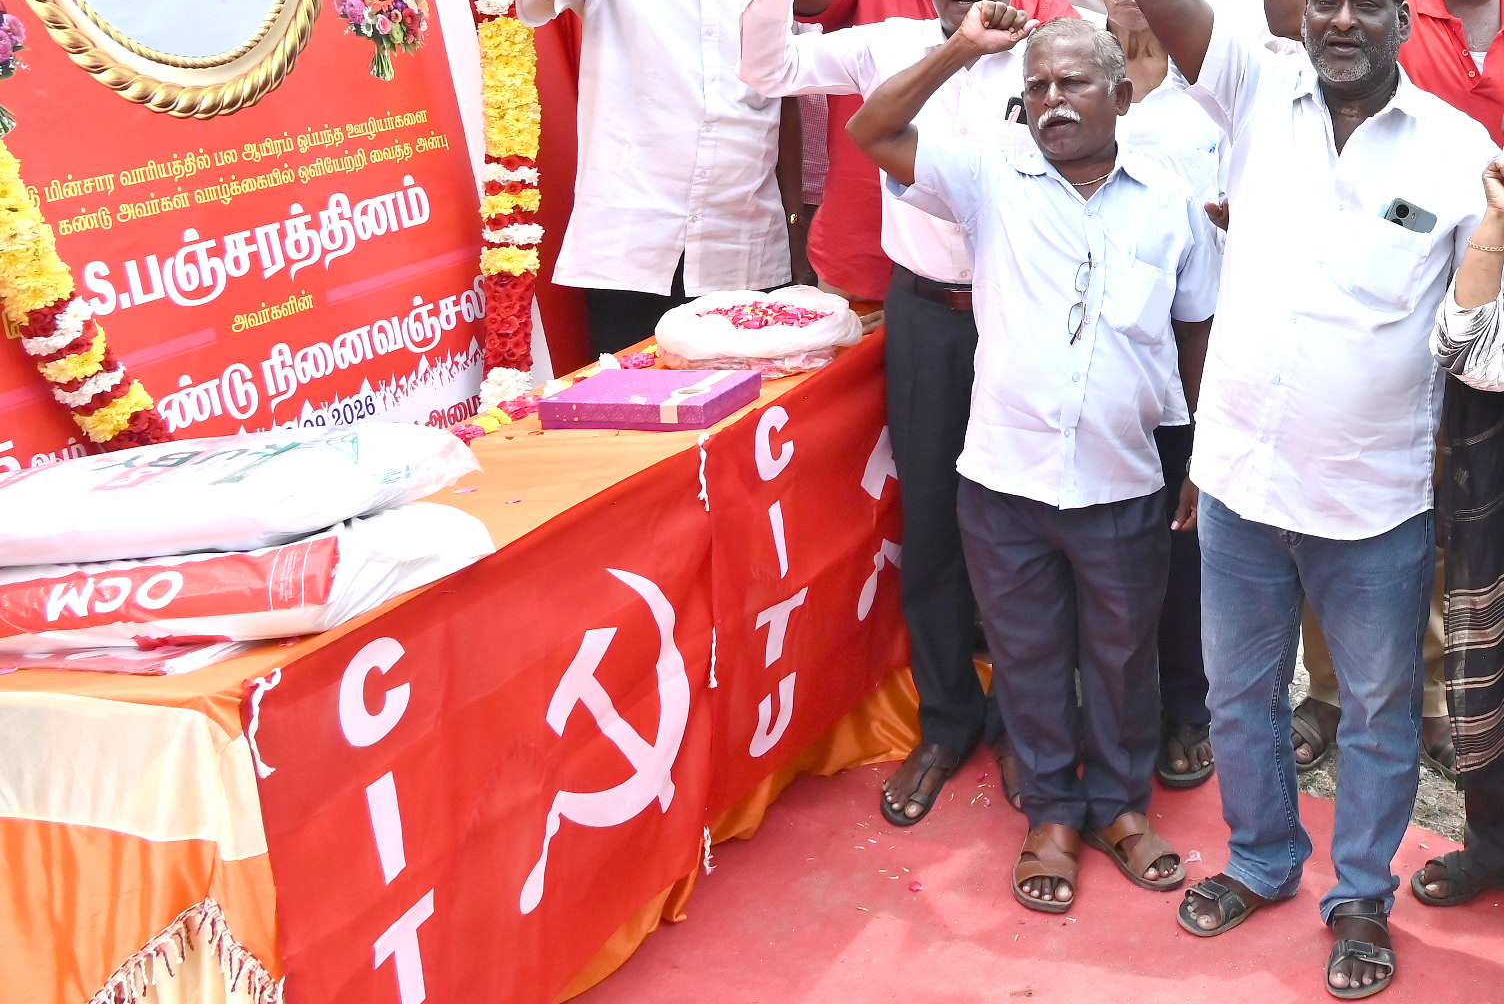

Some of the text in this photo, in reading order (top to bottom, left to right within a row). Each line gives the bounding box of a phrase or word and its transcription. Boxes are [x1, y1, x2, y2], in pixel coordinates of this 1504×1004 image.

[44, 173, 115, 203] மின்சார
[119, 148, 211, 182] வாரியத்தில்
[214, 147, 238, 167] பல
[242, 132, 294, 162] ஆயிரம்
[345, 110, 428, 140] ஊழியர்களை
[58, 131, 450, 236] கண்டு அவர்கள் வாழ்க்கையில் ஒளியேற்றி வைத்த அன்பு
[231, 290, 314, 332] அவர்களின்
[45, 569, 183, 621] OCM
[750, 405, 807, 758] CITU
